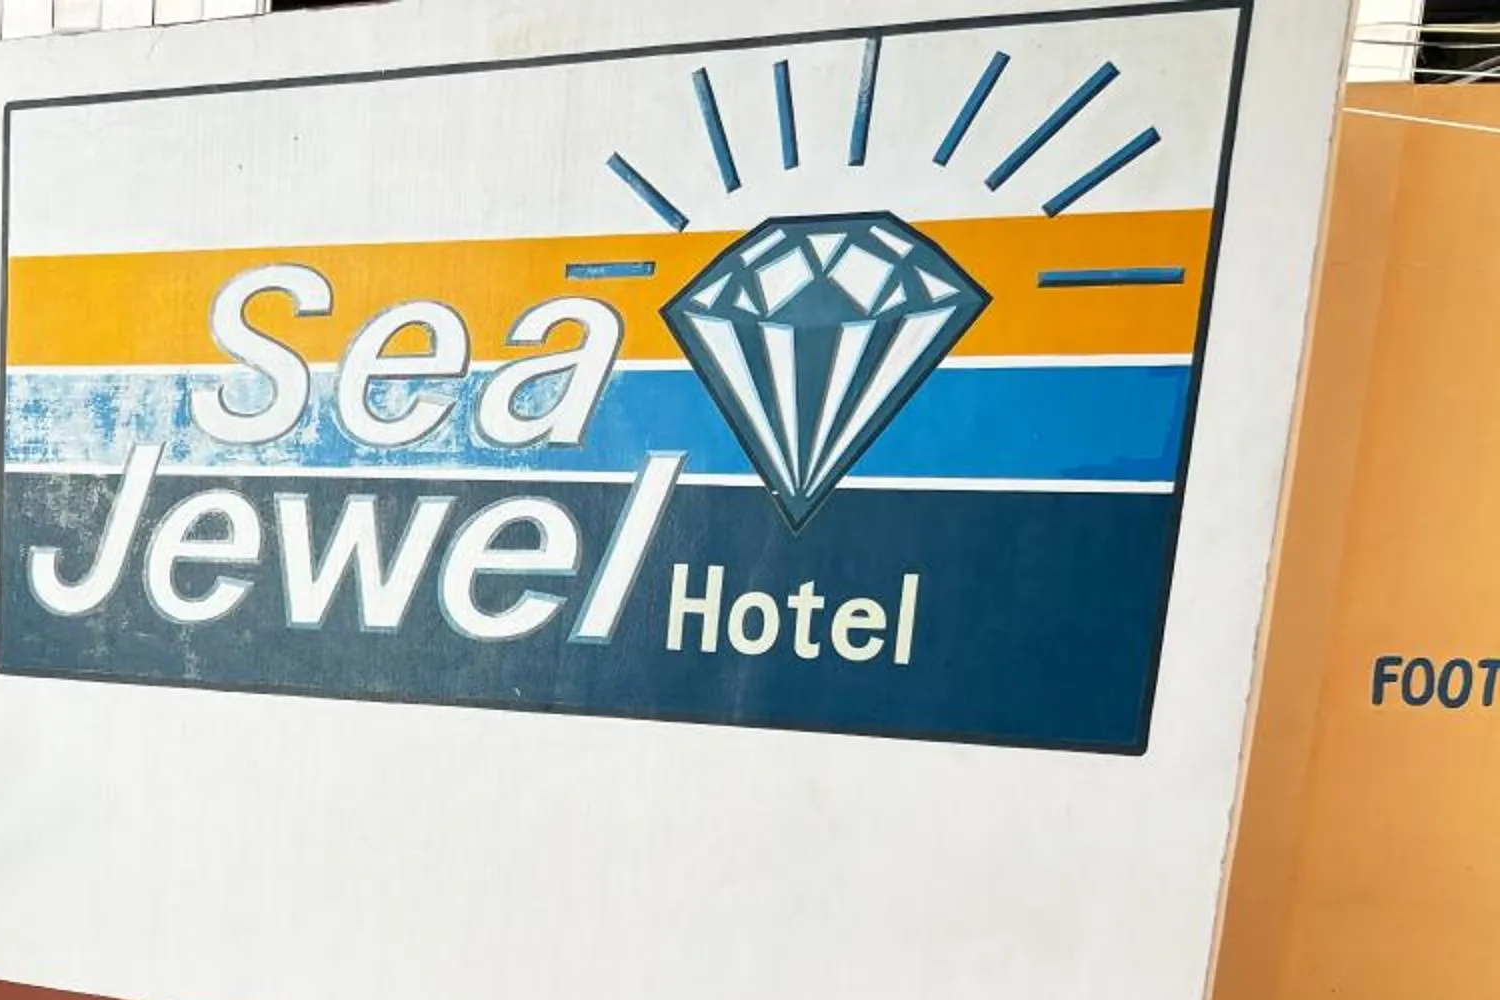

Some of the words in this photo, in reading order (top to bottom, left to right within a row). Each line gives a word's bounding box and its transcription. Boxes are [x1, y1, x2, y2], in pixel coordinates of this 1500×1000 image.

[190, 262, 624, 448] Sea
[28, 441, 690, 645] Jewel
[666, 562, 920, 665] Hotel
[1371, 655, 1500, 708] FOOT
